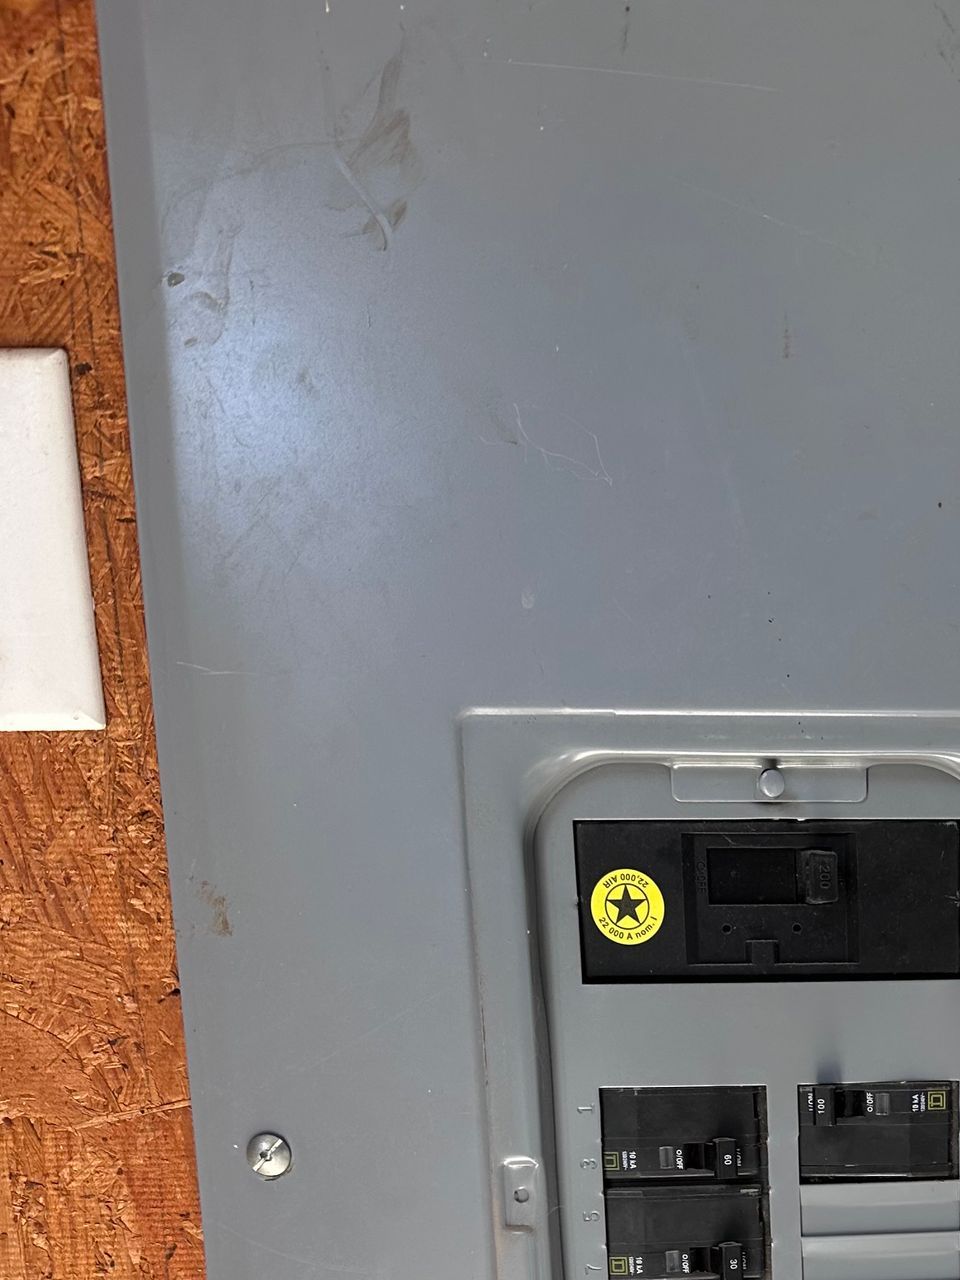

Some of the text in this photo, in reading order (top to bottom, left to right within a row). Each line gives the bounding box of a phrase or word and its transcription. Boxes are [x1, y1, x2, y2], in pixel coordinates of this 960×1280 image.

[603, 873, 649, 889] 22,000 AIR
[819, 865, 831, 889] 200
[599, 917, 608, 928] 22
[608, 926, 624, 939] 000
[627, 932, 633, 940] A
[635, 923, 655, 938] nom.
[577, 1103, 595, 1115] 1
[580, 1158, 597, 1169] 3
[630, 1160, 636, 1169] kA
[724, 1155, 732, 1165] 60
[583, 1211, 600, 1222] 5
[730, 1259, 737, 1269] 30
[584, 1264, 602, 1276] 7
